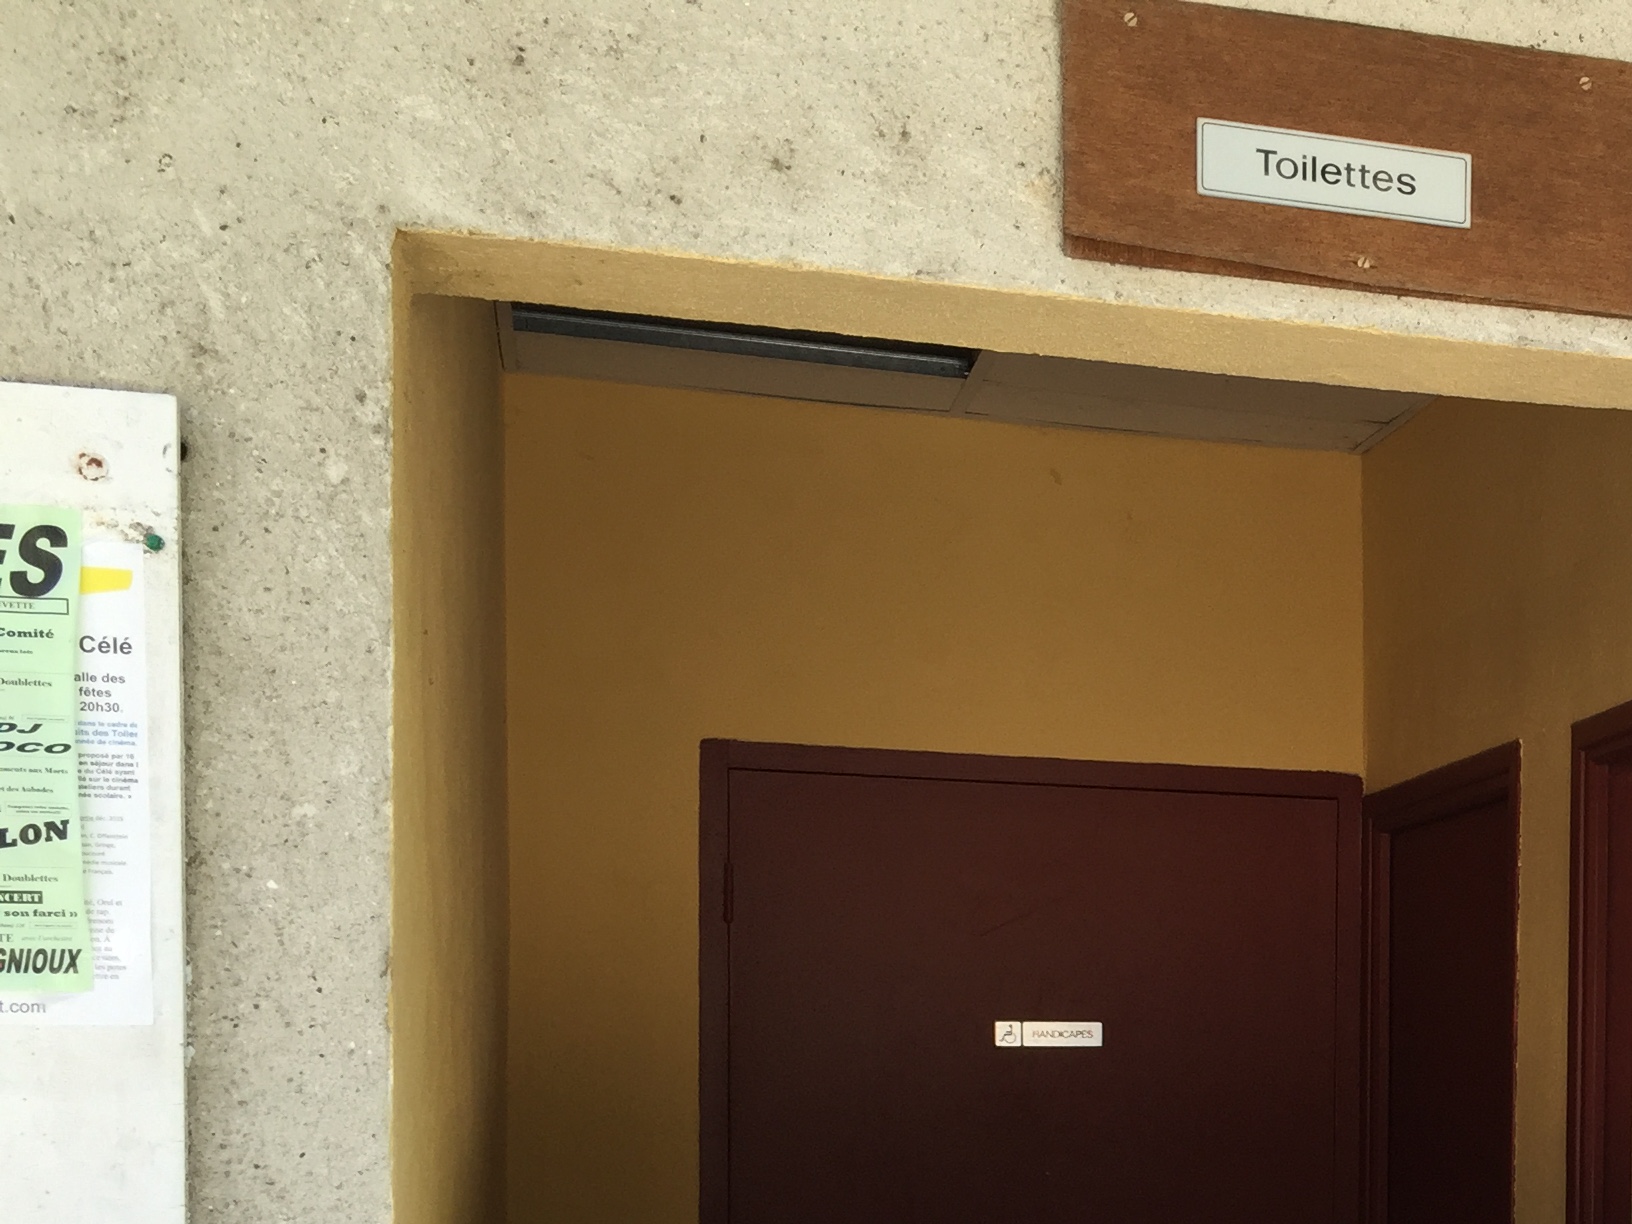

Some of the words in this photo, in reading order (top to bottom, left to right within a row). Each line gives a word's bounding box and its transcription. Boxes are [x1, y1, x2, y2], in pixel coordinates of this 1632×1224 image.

[1256, 148, 1416, 195] Toilettes
[79, 635, 133, 655] Célé
[102, 673, 126, 684] des
[78, 686, 112, 698] fêtes
[3, 874, 59, 882] Doublettes
[4, 909, 30, 918] son
[33, 908, 66, 918] farci
[1032, 1030, 1093, 1039] HANDICAPES
